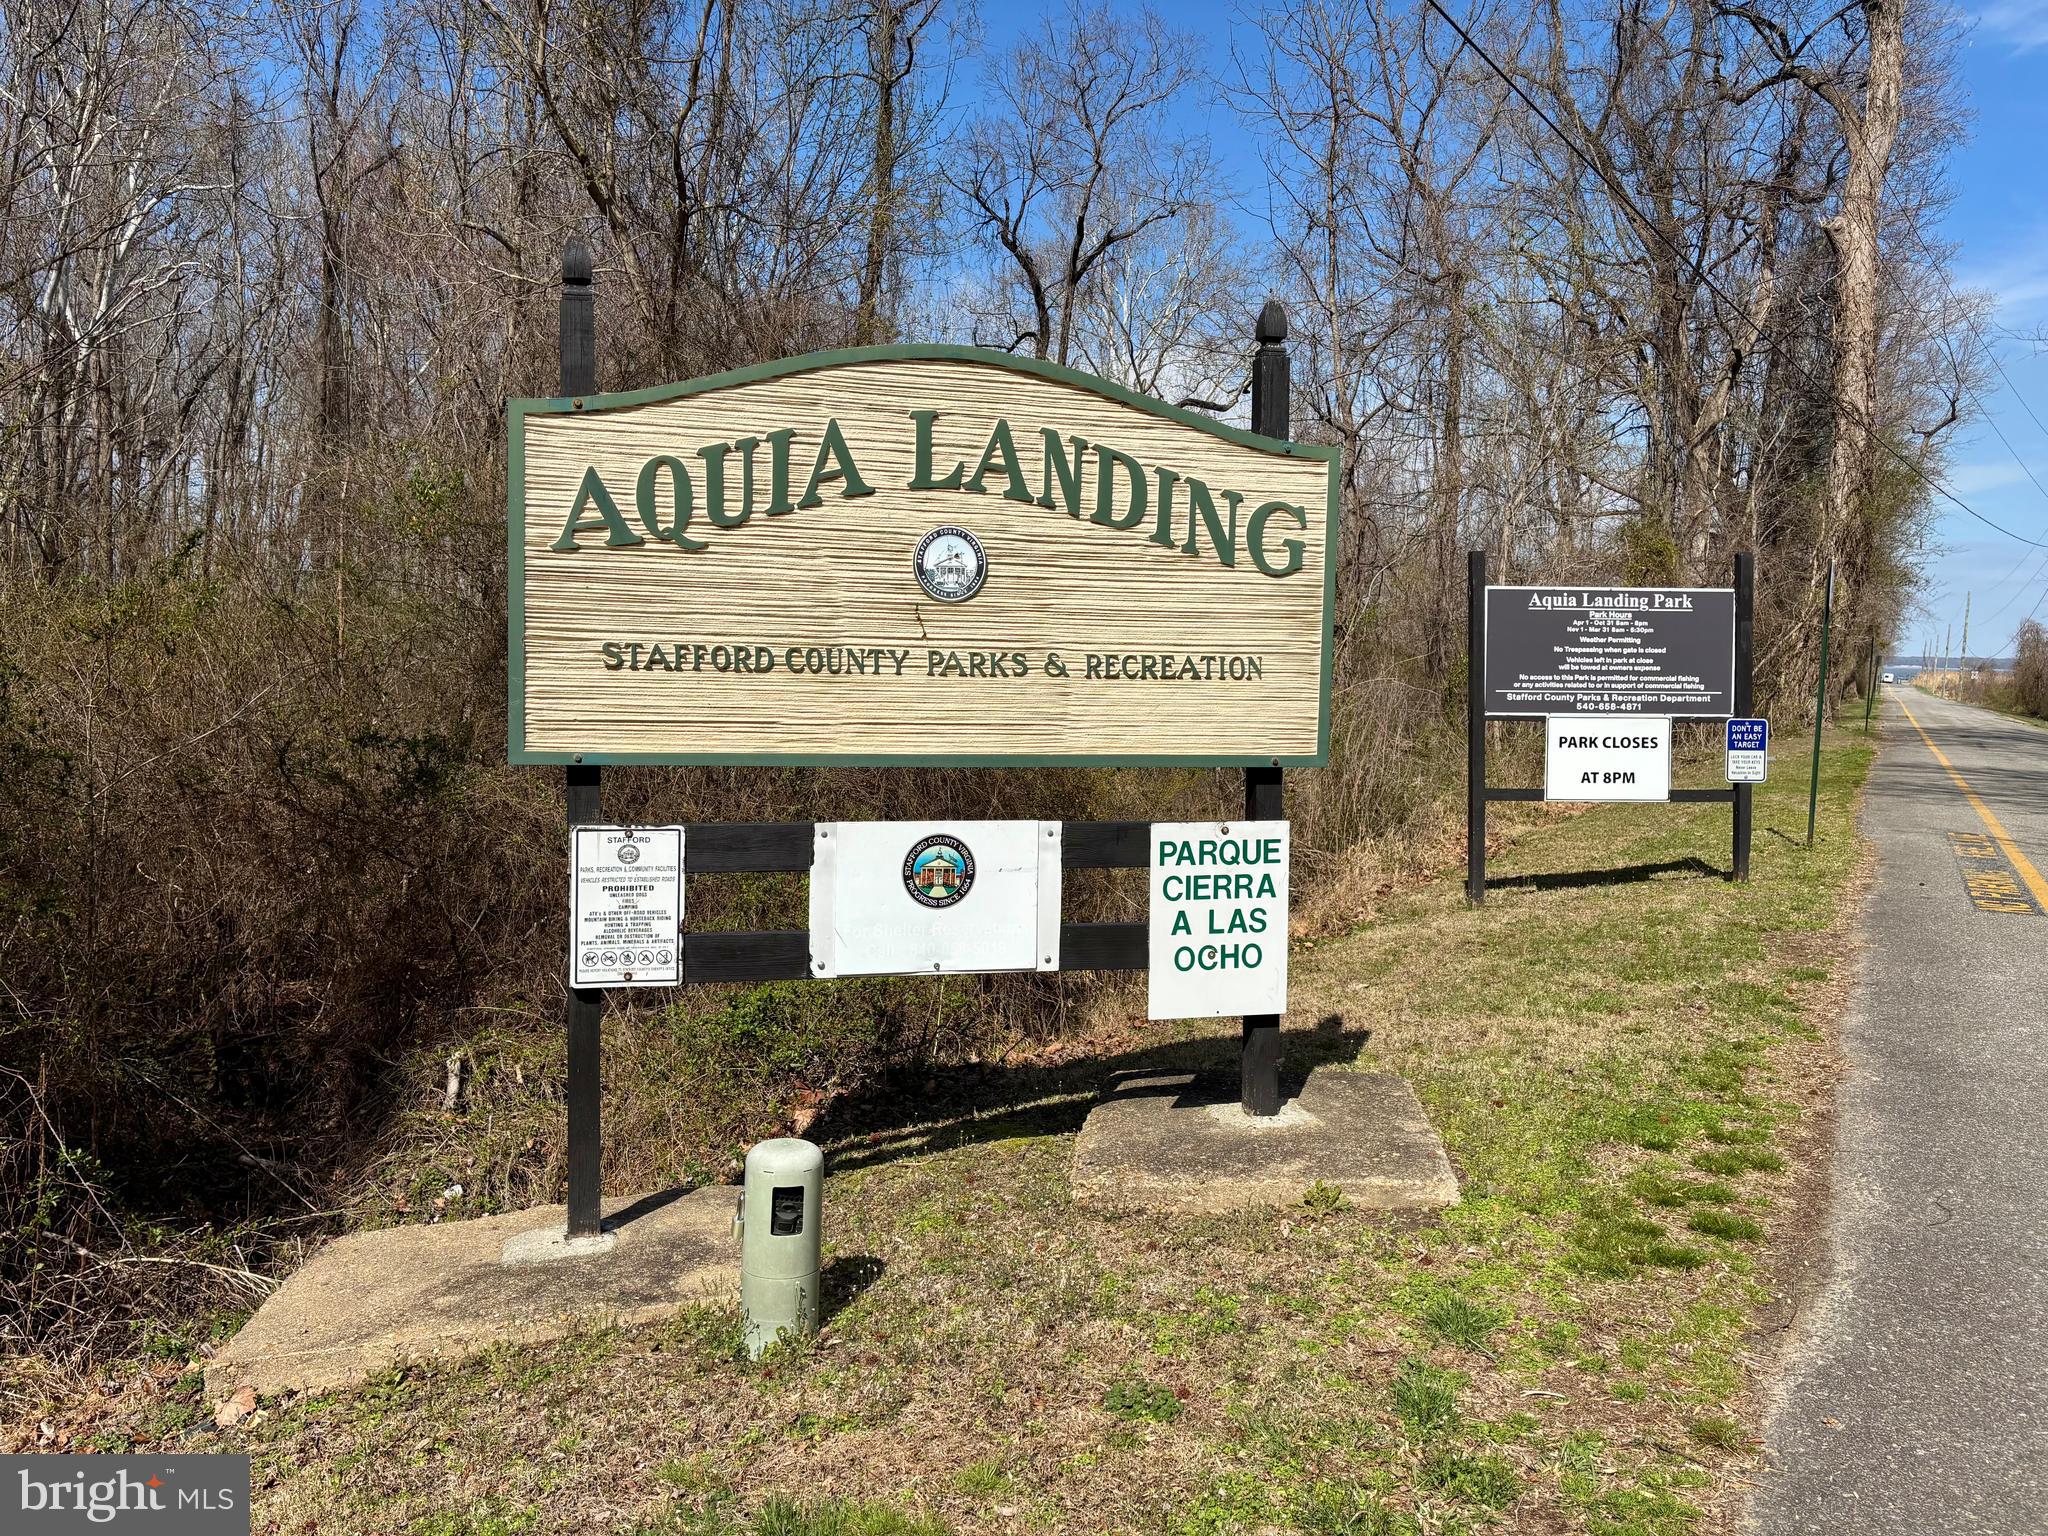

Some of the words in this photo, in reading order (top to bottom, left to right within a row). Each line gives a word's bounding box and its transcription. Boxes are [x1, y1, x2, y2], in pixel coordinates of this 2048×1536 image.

[550, 416, 875, 551] AQUIA
[906, 410, 1308, 578] LANDING
[918, 533, 938, 563] STAFFORD
[940, 529, 965, 537] COUNTY
[967, 535, 983, 564] VIRGINIA
[1528, 592, 1577, 610] Aquia
[1582, 592, 1649, 611] Landing
[1654, 594, 1693, 610] Park
[1565, 646, 1603, 654] Trespassing
[1608, 636, 1641, 644] Permitting
[601, 642, 774, 674] STAFFORD
[786, 646, 910, 676] COUNTY
[927, 650, 1029, 678] PARKS
[1043, 652, 1070, 678] &
[1084, 654, 1264, 681] RECREATION
[1506, 693, 1542, 701] Stafford
[1544, 693, 1574, 702] County
[1612, 694, 1657, 702] Recreation
[1660, 695, 1711, 703] Department
[1576, 702, 1641, 710] 540-658-4871
[1559, 736, 1598, 748] PARK
[1602, 736, 1658, 748] CLOSES
[1581, 772, 1599, 783] AT
[1603, 772, 1635, 784] 8PM
[904, 842, 928, 876] STAFFORD
[928, 837, 959, 847] COUNTY
[958, 844, 974, 874] VIRGINIA
[1159, 839, 1281, 866] PARQUE
[906, 880, 938, 906] PROGRESS
[938, 892, 960, 906] SINCE
[960, 878, 971, 895] 1664
[1162, 873, 1276, 901] CIERRA
[1171, 910, 1192, 936] A
[1208, 908, 1267, 934] LAS
[1174, 943, 1262, 972] OCHO
